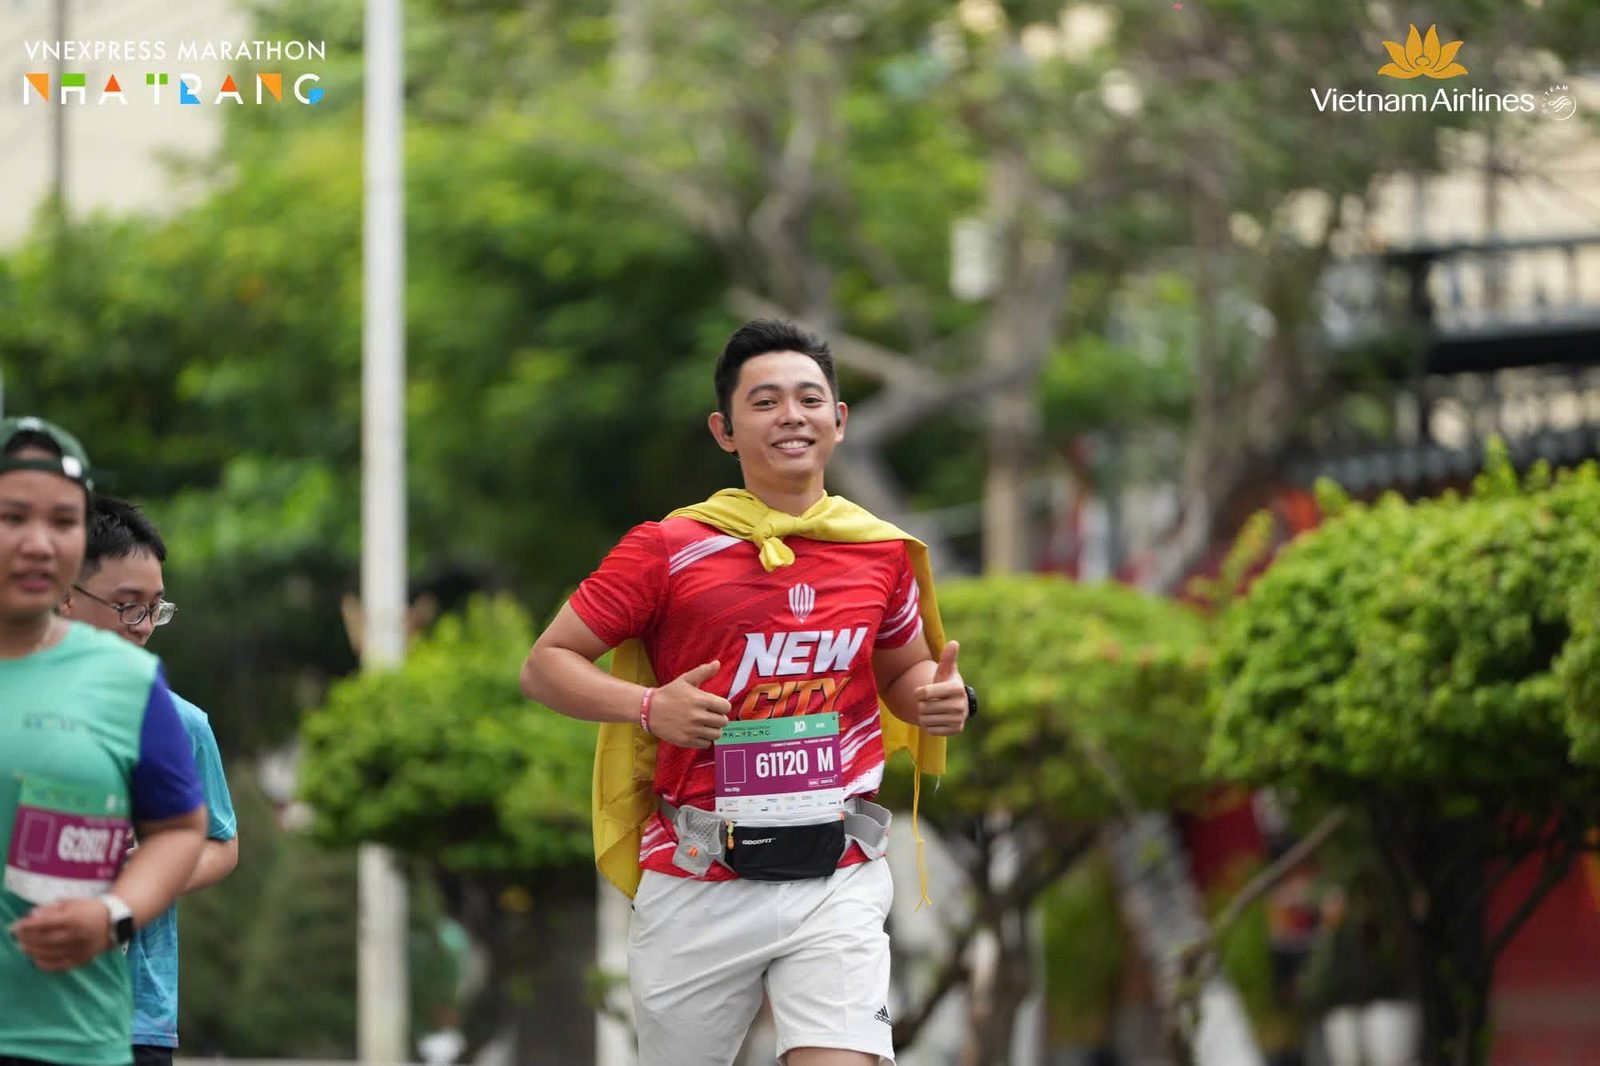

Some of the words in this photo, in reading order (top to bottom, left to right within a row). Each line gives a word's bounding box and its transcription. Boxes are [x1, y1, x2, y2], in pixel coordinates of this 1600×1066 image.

[728, 627, 869, 700] NEW
[738, 676, 852, 720] CITY
[755, 749, 809, 778] 61120
[816, 746, 834, 772] M
